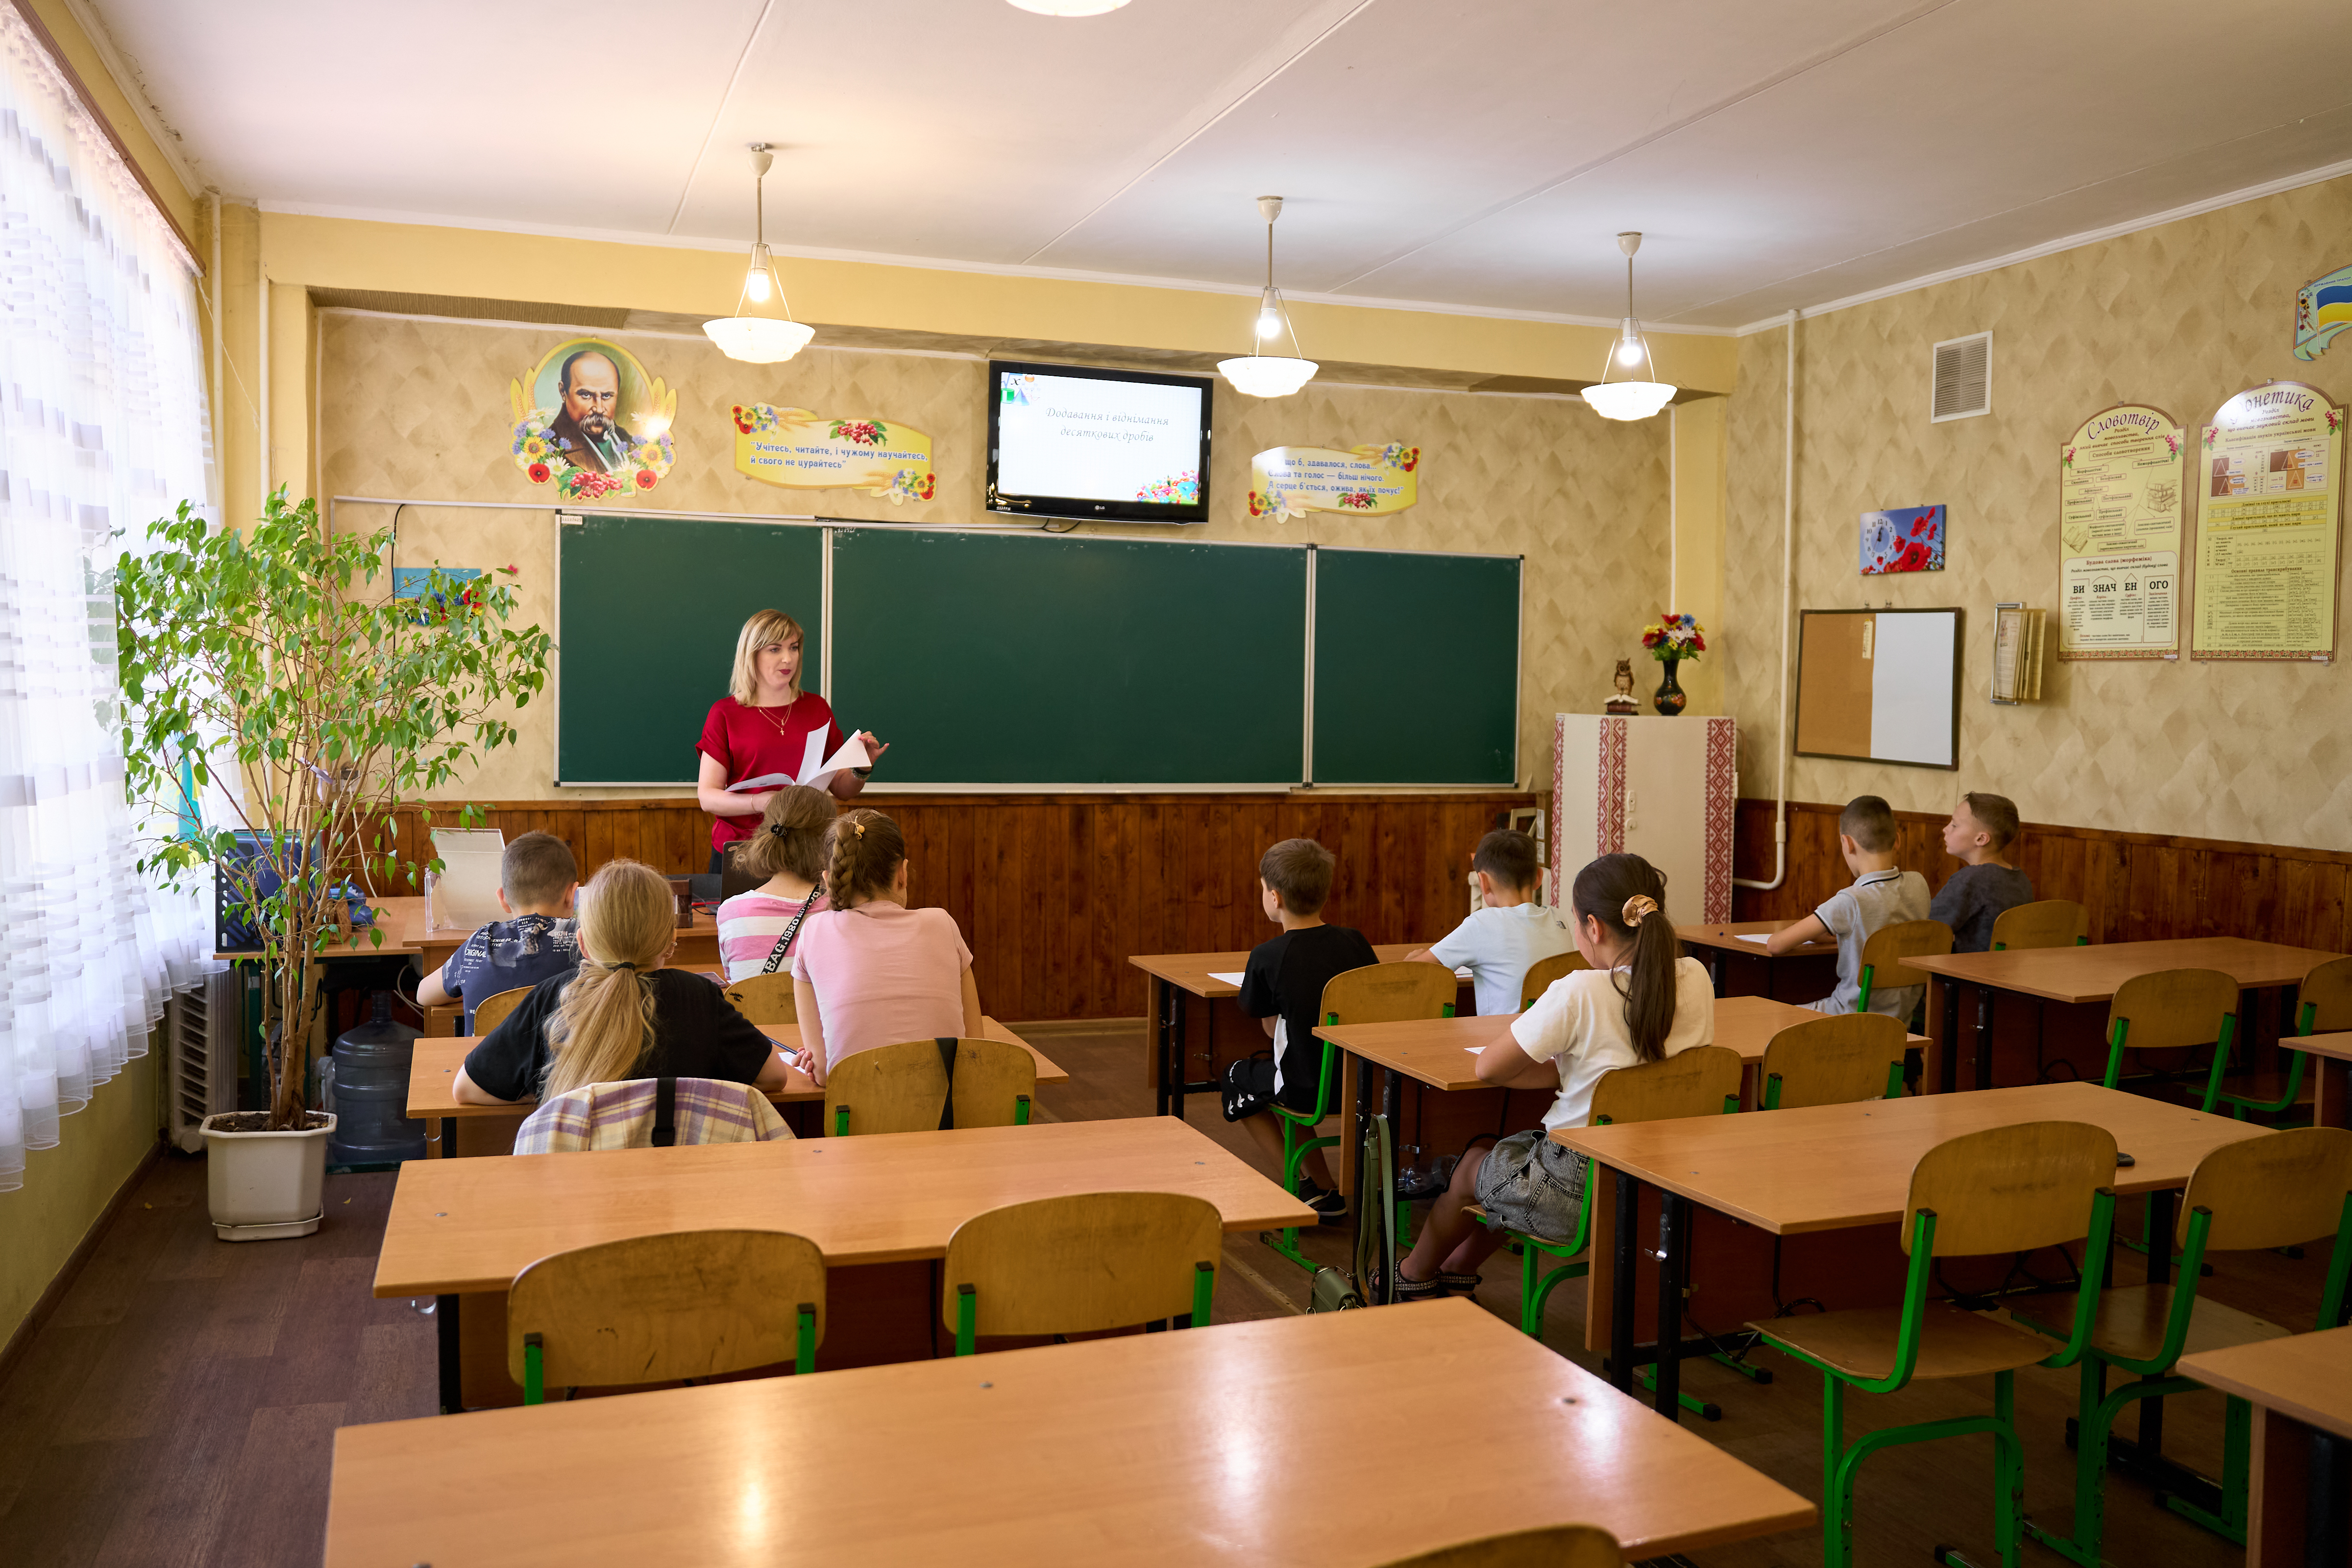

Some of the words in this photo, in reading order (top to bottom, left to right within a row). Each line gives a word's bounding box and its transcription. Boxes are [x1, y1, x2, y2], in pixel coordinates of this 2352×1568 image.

[1046, 407, 1102, 420] Додавання
[1106, 412, 1110, 420] і
[1112, 411, 1169, 425] віднімання
[2088, 412, 2159, 440] Словотвір
[1061, 424, 1121, 441] десяткових
[1123, 429, 1153, 443] дробів
[795, 446, 832, 456] читайте,
[841, 449, 875, 459] чужому
[878, 451, 928, 461] научайтесь,
[1298, 458, 1304, 466] б,
[1338, 472, 1358, 480] більш
[1361, 473, 1384, 482] нічого.
[1267, 481, 1274, 490] А
[2073, 585, 2085, 593] ВИ
[2093, 583, 2116, 592] ЗНАЧ
[2125, 582, 2137, 590] ЕН
[2150, 580, 2168, 589] ОГО
